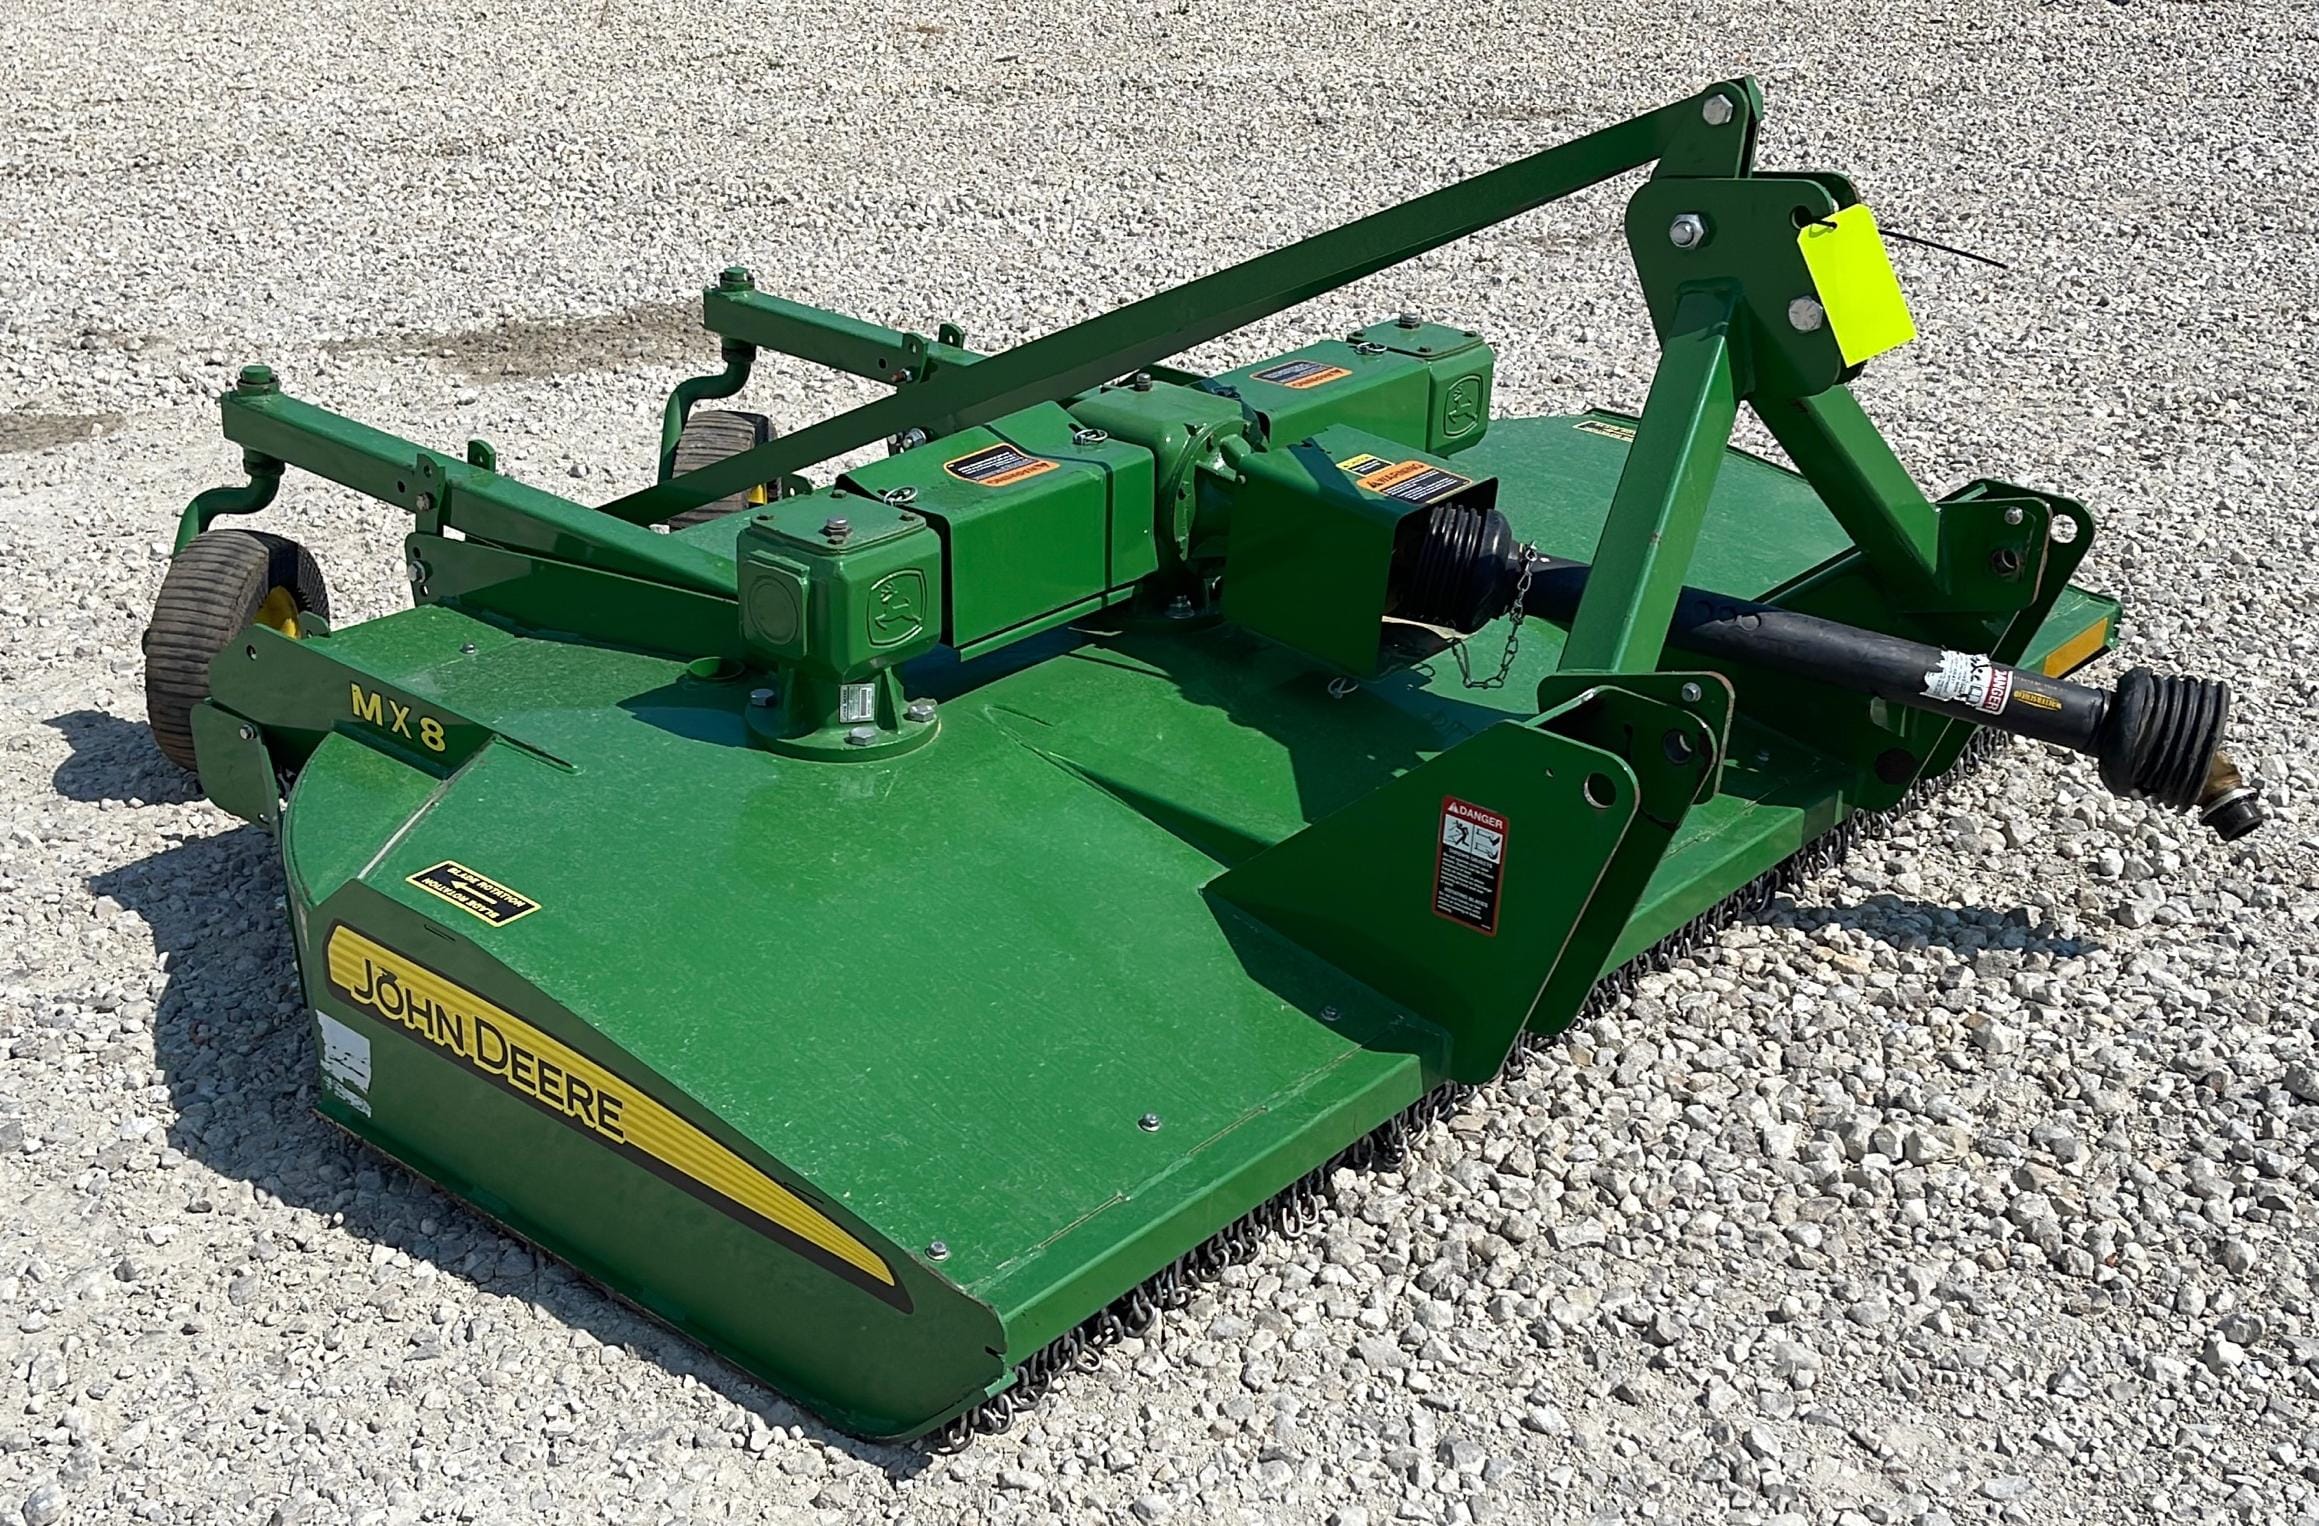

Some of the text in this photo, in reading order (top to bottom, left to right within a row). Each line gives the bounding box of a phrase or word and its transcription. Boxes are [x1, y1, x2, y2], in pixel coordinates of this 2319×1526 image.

[1459, 805, 1503, 829] DANGER
[421, 877, 500, 919] ROTATION BLADE
[447, 867, 526, 908] BLADE ROTATION
[353, 958, 624, 1140] JOHN DEERE
